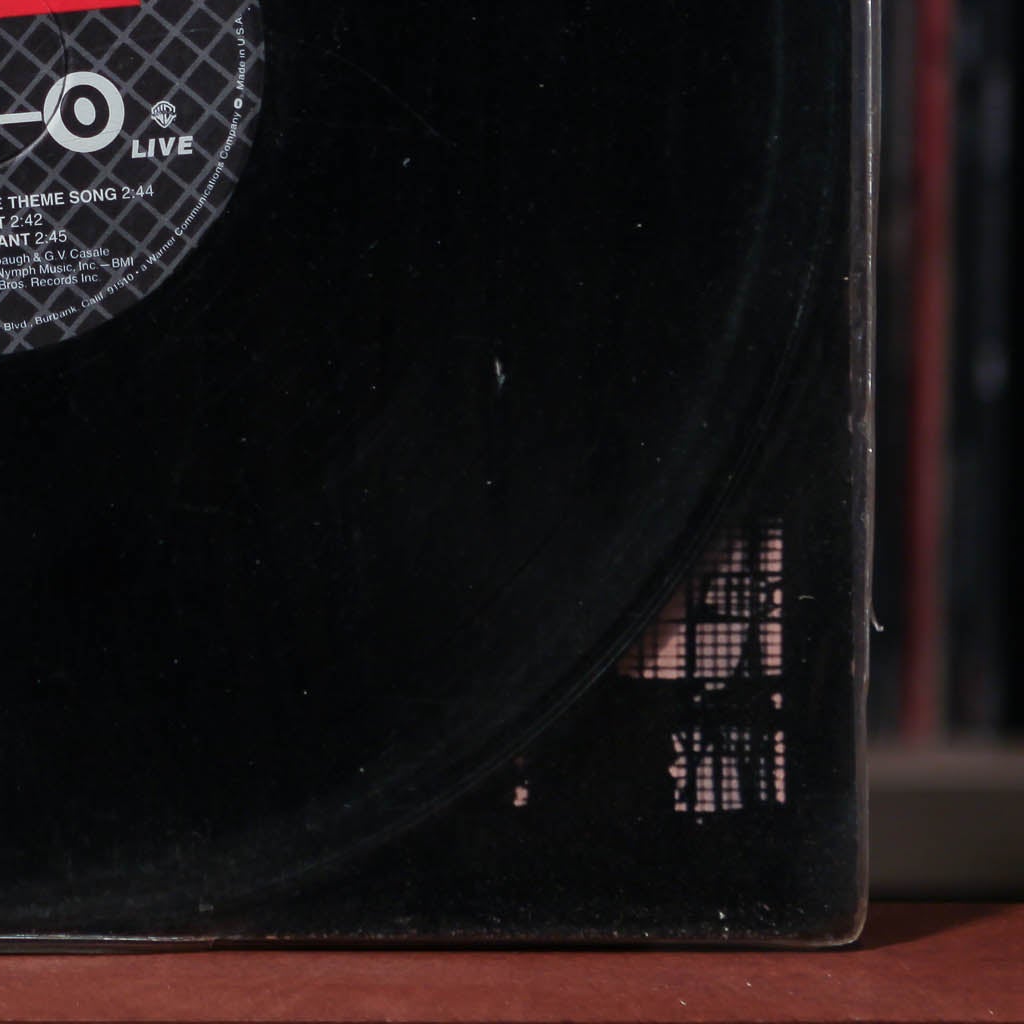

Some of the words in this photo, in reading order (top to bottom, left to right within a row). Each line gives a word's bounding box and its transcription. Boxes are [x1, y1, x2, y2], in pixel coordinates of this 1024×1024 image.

[239, 49, 246, 58] in
[236, 60, 246, 90] Made
[219, 111, 243, 159] Company
[131, 135, 194, 159] LIVE
[8, 191, 65, 209] THEME
[69, 187, 117, 205] SONG
[121, 183, 155, 199] 2:44
[174, 161, 225, 237] Communications
[10, 213, 43, 228] 2:42
[34, 229, 68, 244] 2:45
[33, 252, 42, 263] &
[70, 247, 110, 260] Casale
[147, 237, 176, 265] Warner
[39, 263, 76, 275] Music,
[112, 256, 135, 269] BMI
[140, 263, 148, 272] a
[31, 274, 78, 288] Records
[107, 272, 134, 295] 91510
